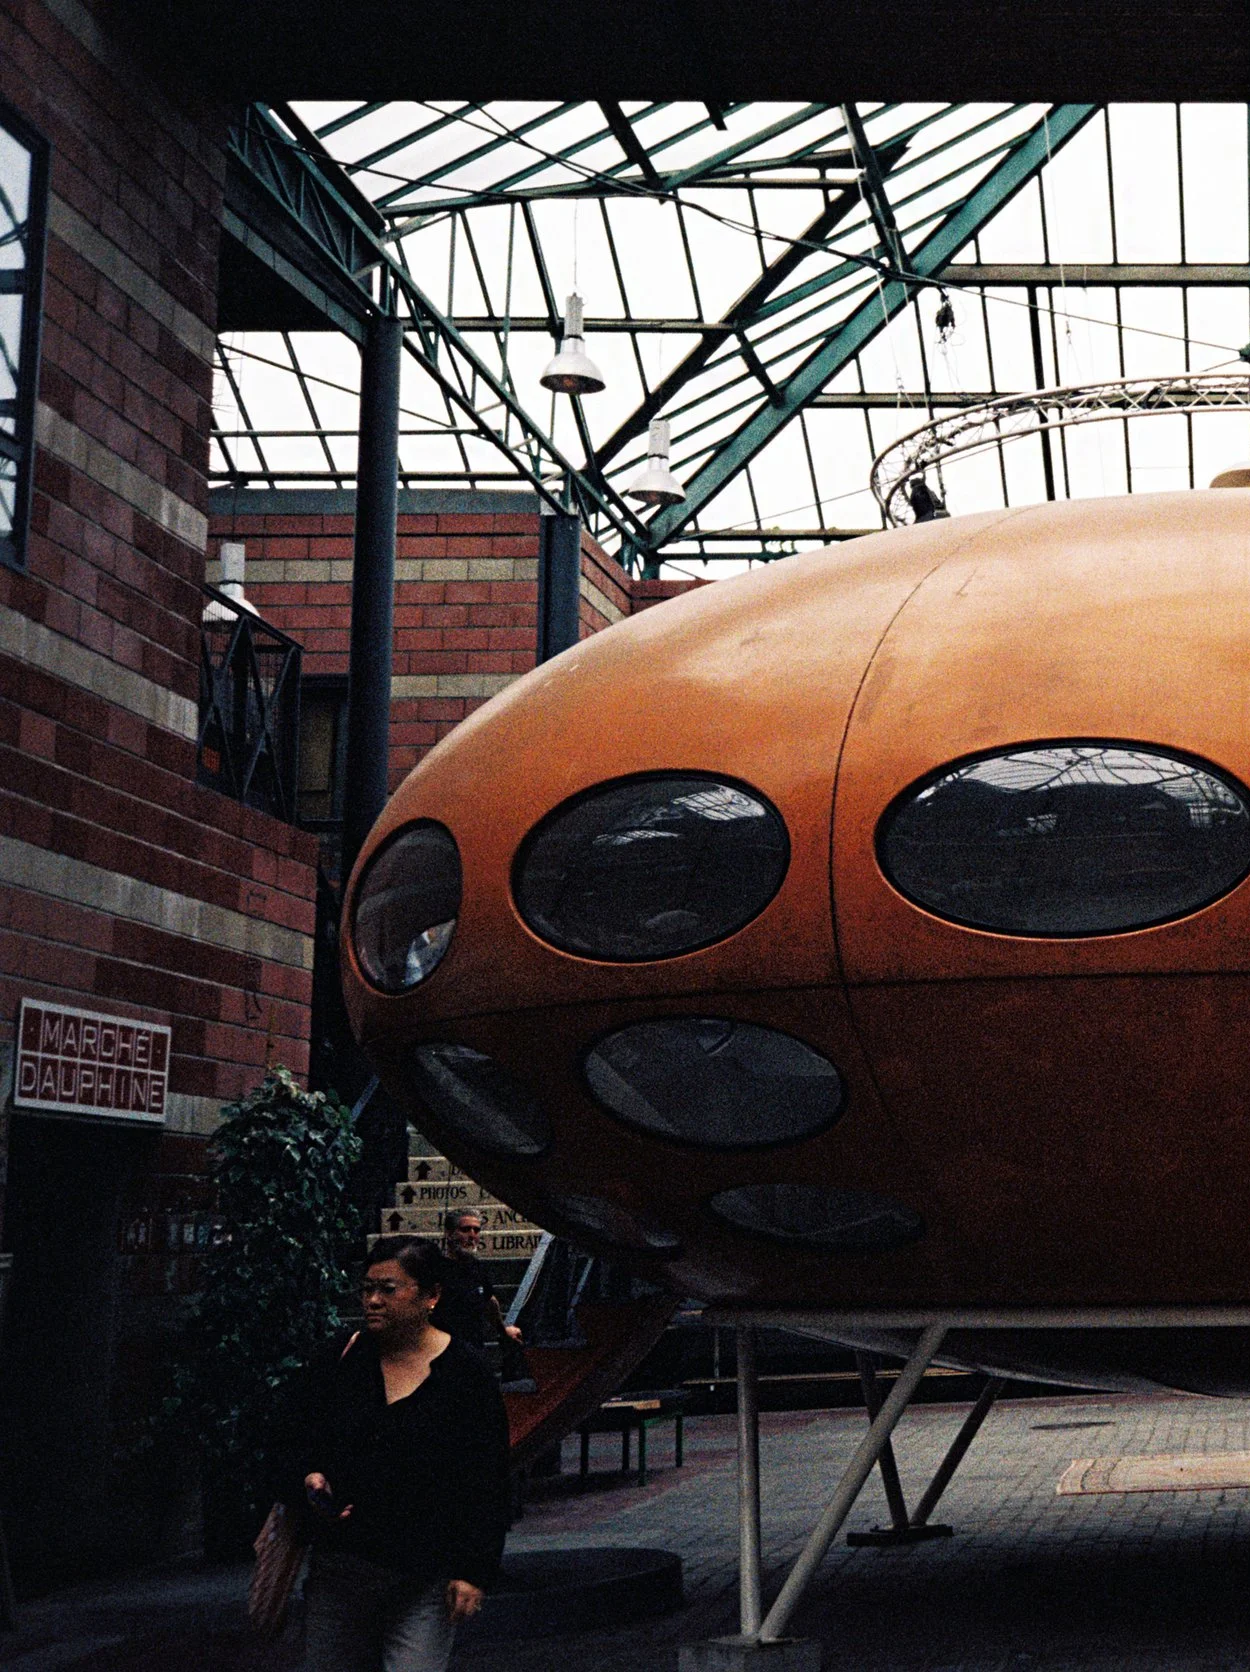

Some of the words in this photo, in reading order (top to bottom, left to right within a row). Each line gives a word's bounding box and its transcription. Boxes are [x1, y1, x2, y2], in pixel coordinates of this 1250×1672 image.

[43, 1017, 150, 1064] MARCHÉ
[20, 1061, 164, 1107] DAUPHINE
[420, 1186, 467, 1200] PHOTOS
[493, 1235, 542, 1250] LIBRAI
